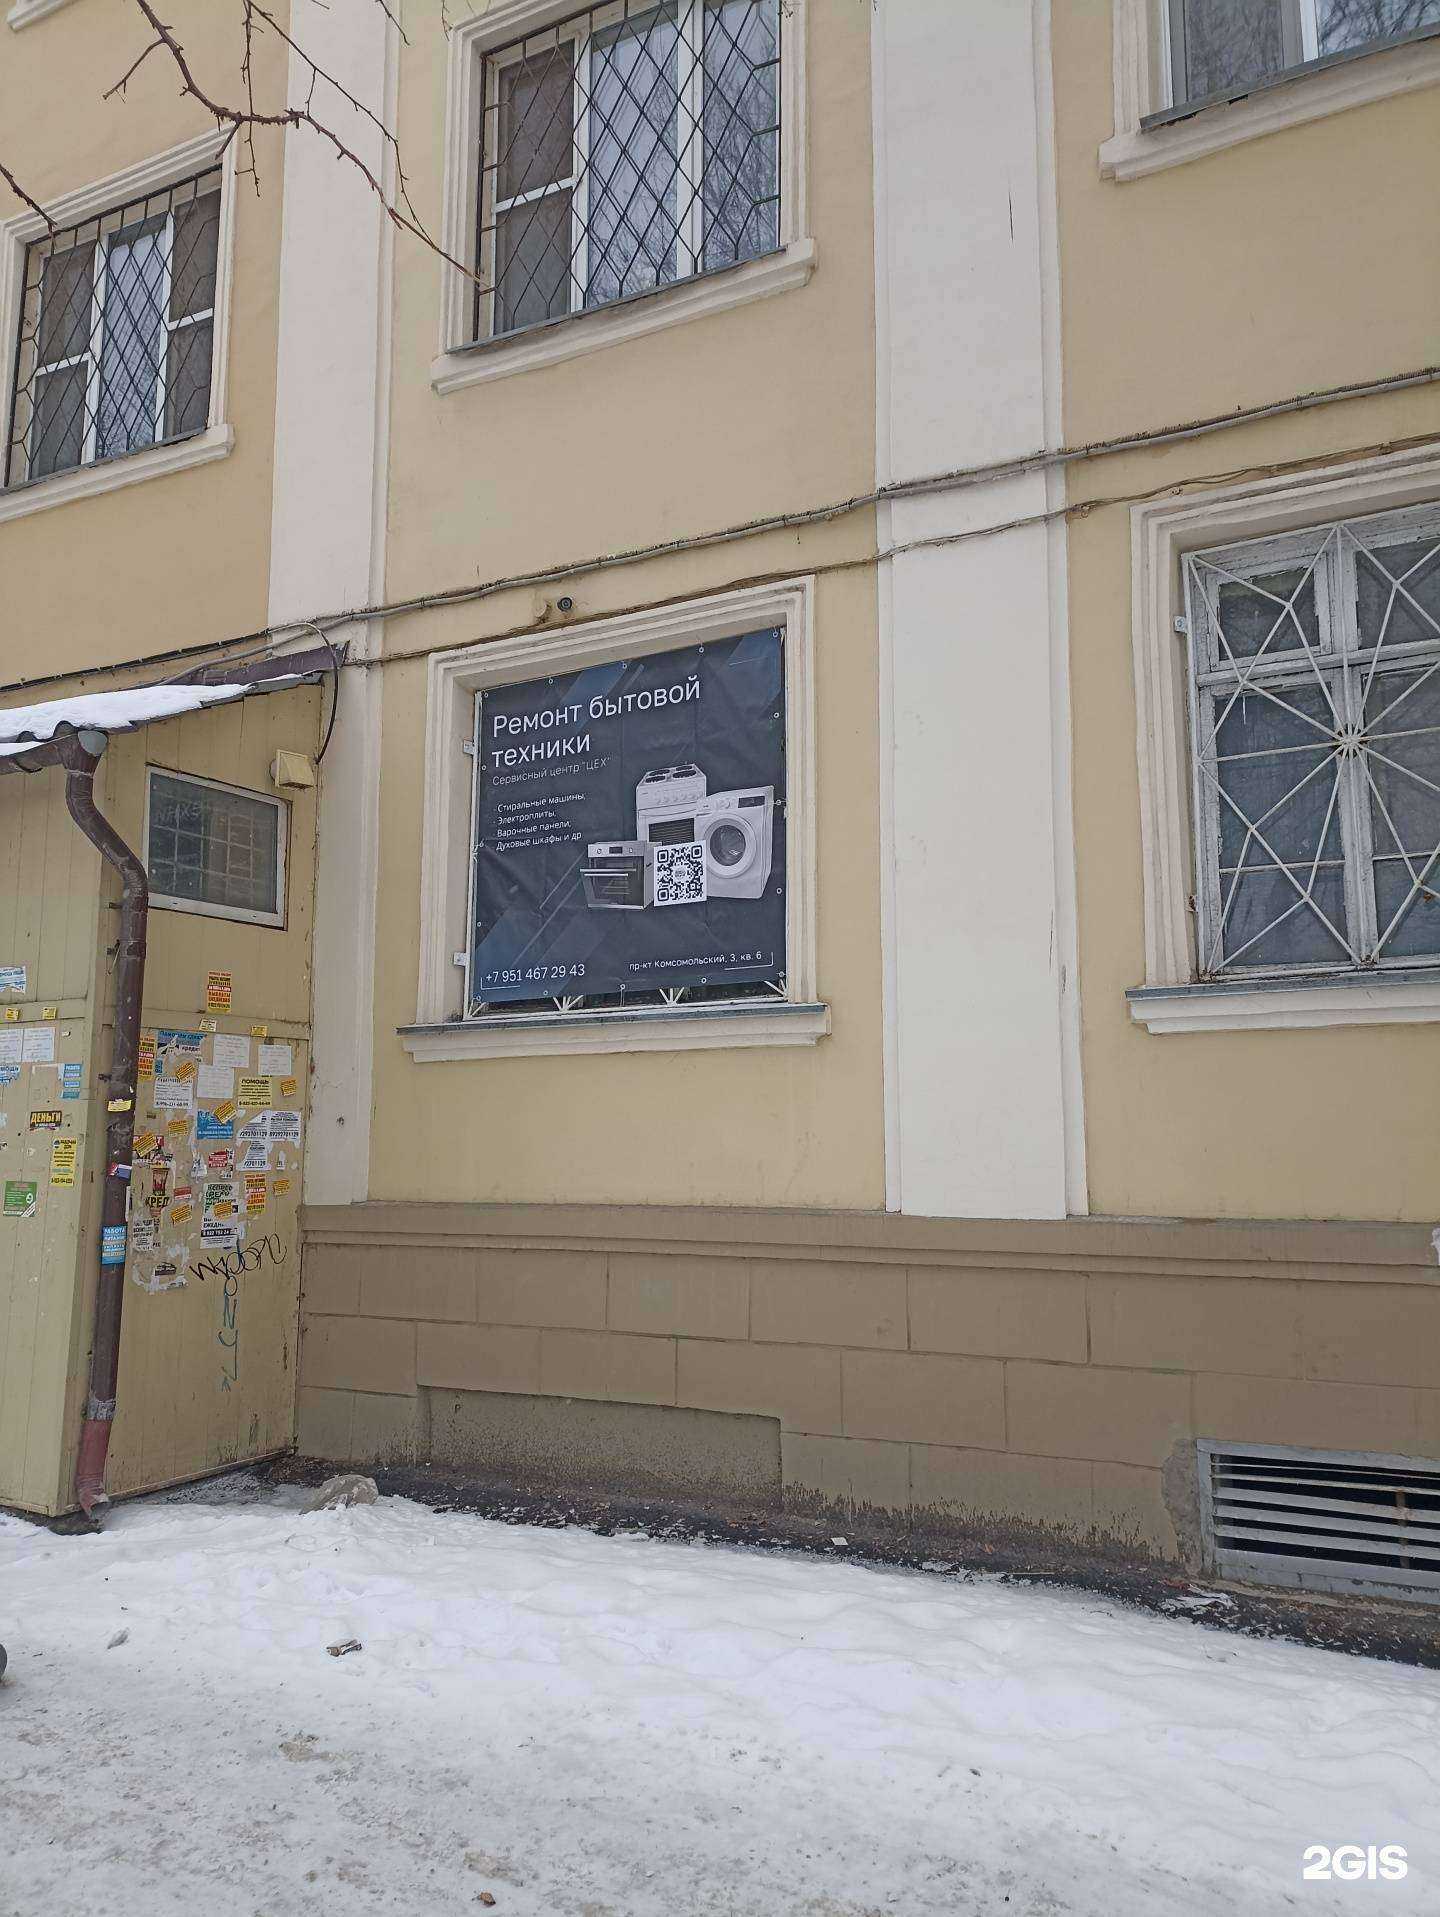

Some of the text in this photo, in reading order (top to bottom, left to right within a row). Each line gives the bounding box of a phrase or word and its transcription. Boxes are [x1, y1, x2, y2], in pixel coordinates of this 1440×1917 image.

[493, 674, 701, 738] Ремонт бытовой
[492, 734, 590, 768] техники
[492, 767, 547, 786] Сервисный
[550, 764, 580, 777] центр
[497, 797, 547, 813] Стиральные
[497, 824, 538, 838] Варочные
[496, 838, 531, 852] Духовые
[532, 834, 562, 845] шкафы
[629, 961, 652, 972] пр-кт
[740, 952, 754, 961] кв.
[756, 950, 762, 960] 6
[486, 963, 585, 983] +7 951 467 29 43
[31, 1111, 61, 1123] ДЕНЬГИ
